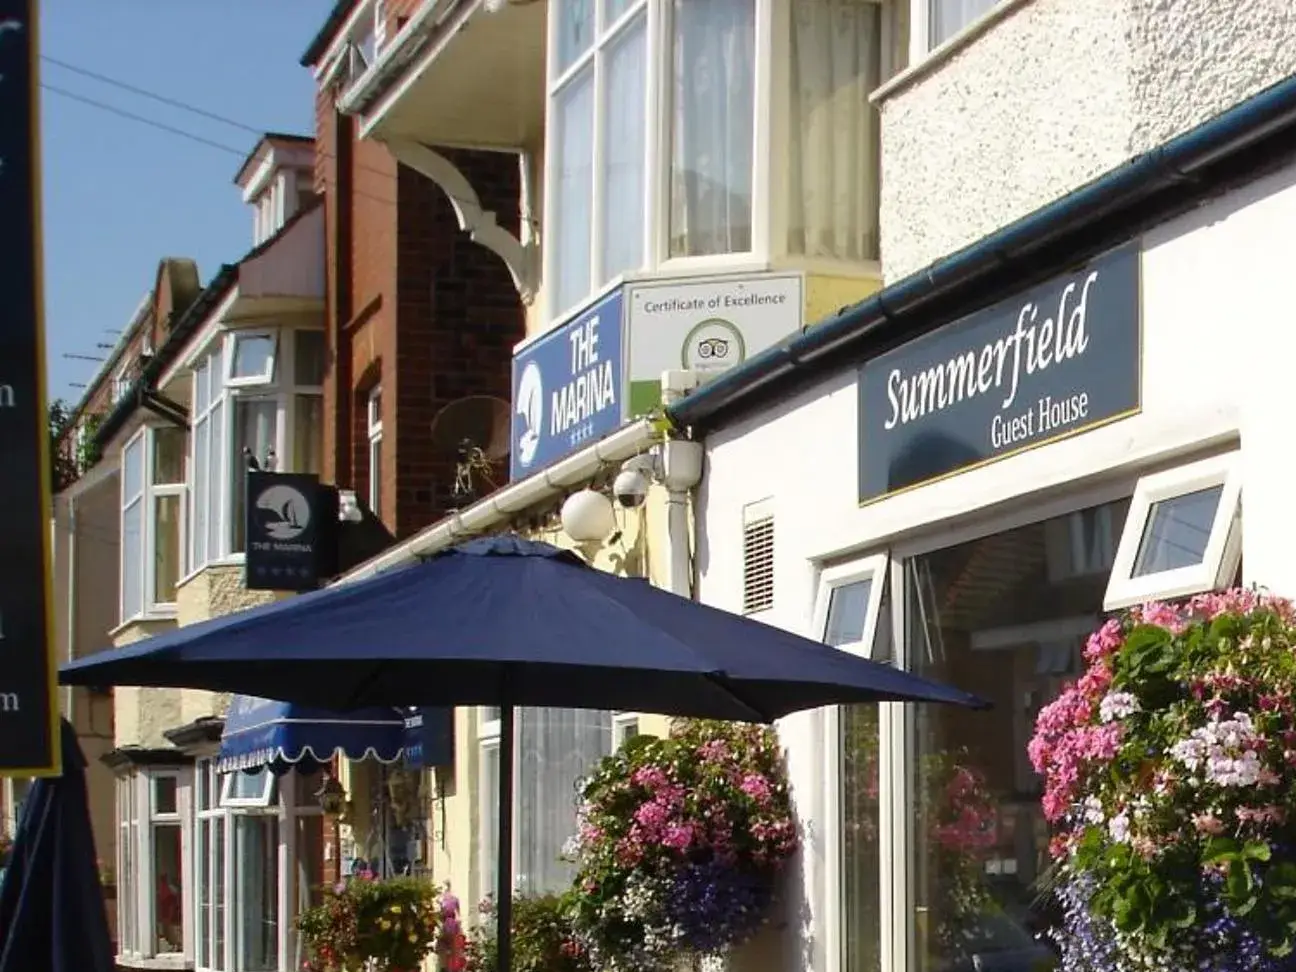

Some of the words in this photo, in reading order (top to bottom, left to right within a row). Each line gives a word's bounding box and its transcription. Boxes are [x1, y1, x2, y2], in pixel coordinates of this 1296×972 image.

[644, 298, 705, 313] Certificate
[708, 296, 720, 309] of
[724, 293, 786, 308] Excellence
[570, 315, 600, 375] THE
[884, 270, 1098, 430] Summerfield
[551, 359, 616, 436] MARINA
[991, 408, 1034, 448] Guest
[1038, 392, 1089, 433] House
[251, 541, 270, 551] THE
